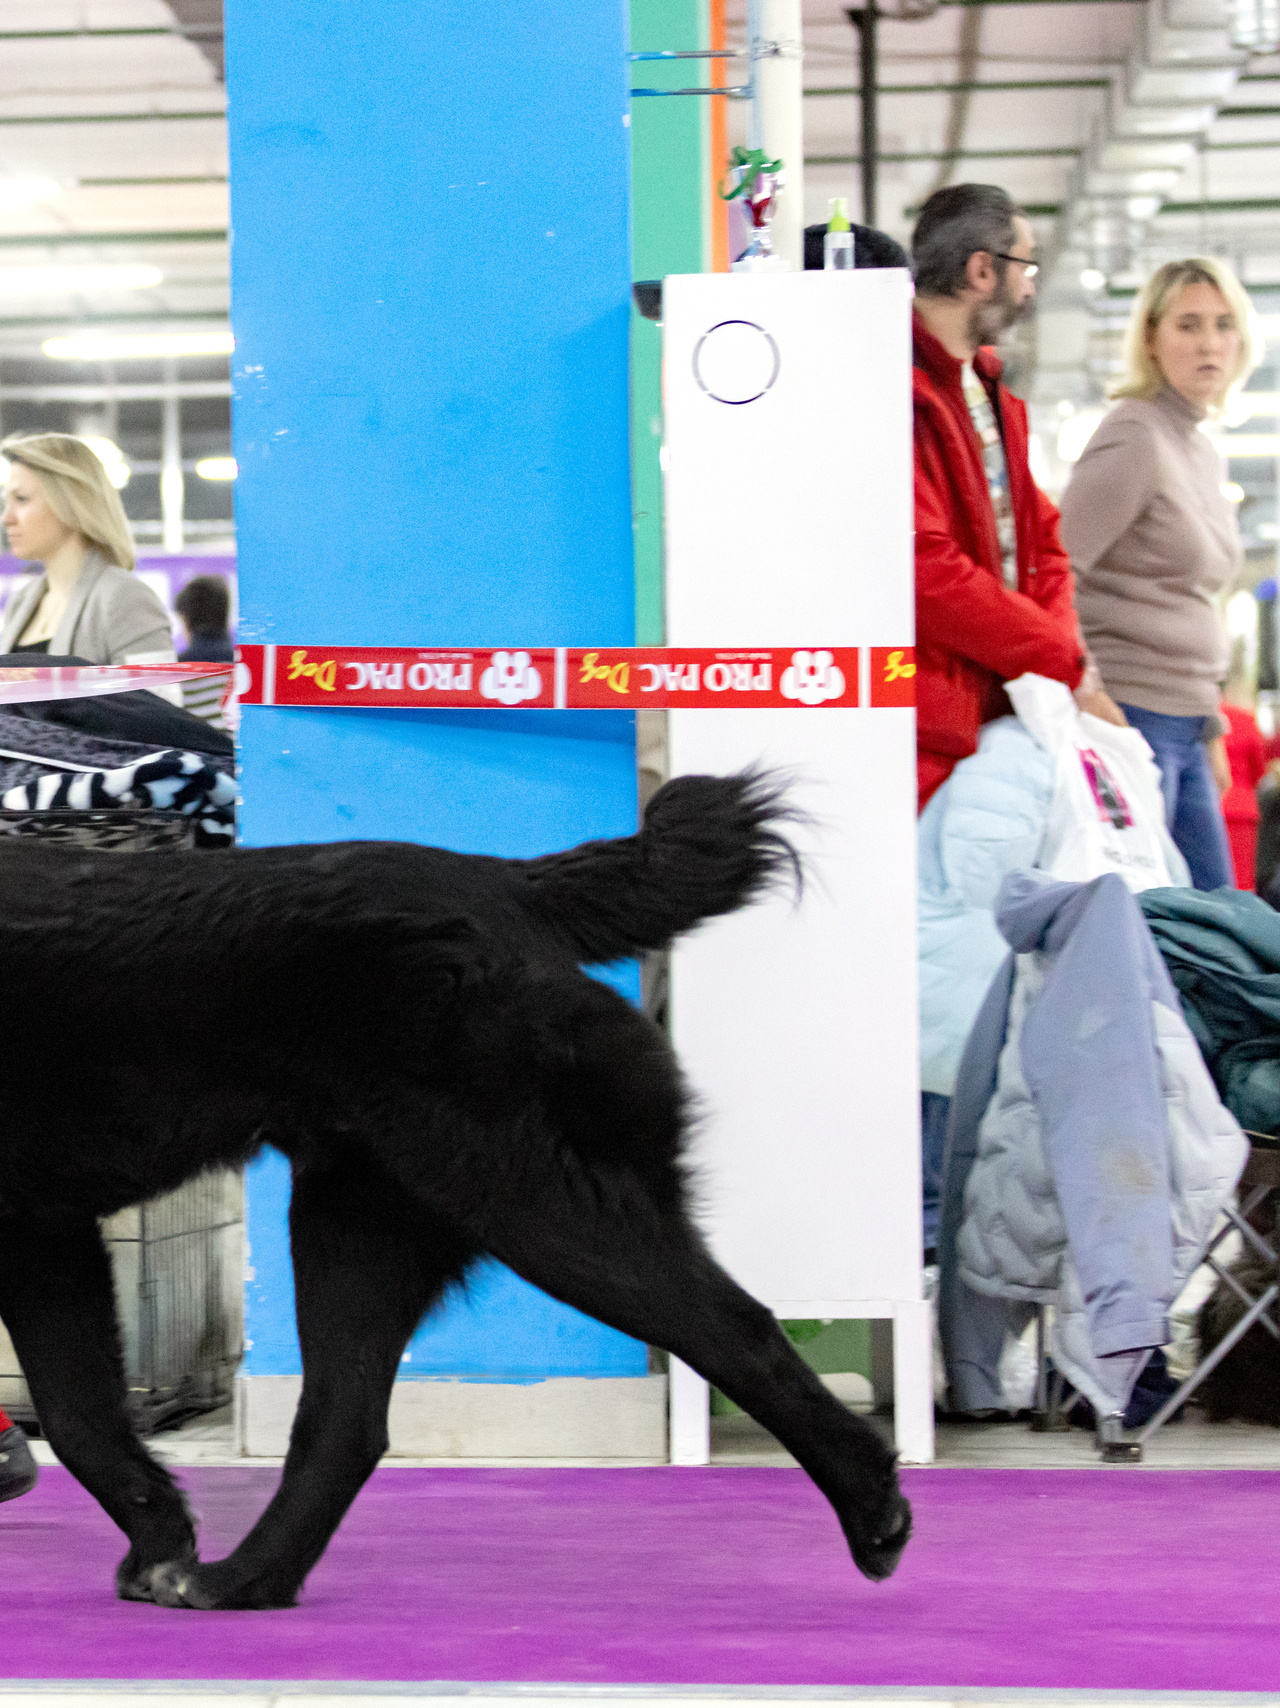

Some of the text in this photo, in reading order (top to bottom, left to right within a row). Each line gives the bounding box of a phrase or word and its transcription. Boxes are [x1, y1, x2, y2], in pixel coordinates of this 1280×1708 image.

[287, 650, 473, 692] PRO PAC Dog
[578, 652, 773, 694] PRO PAC Dog
[883, 650, 916, 682] og
